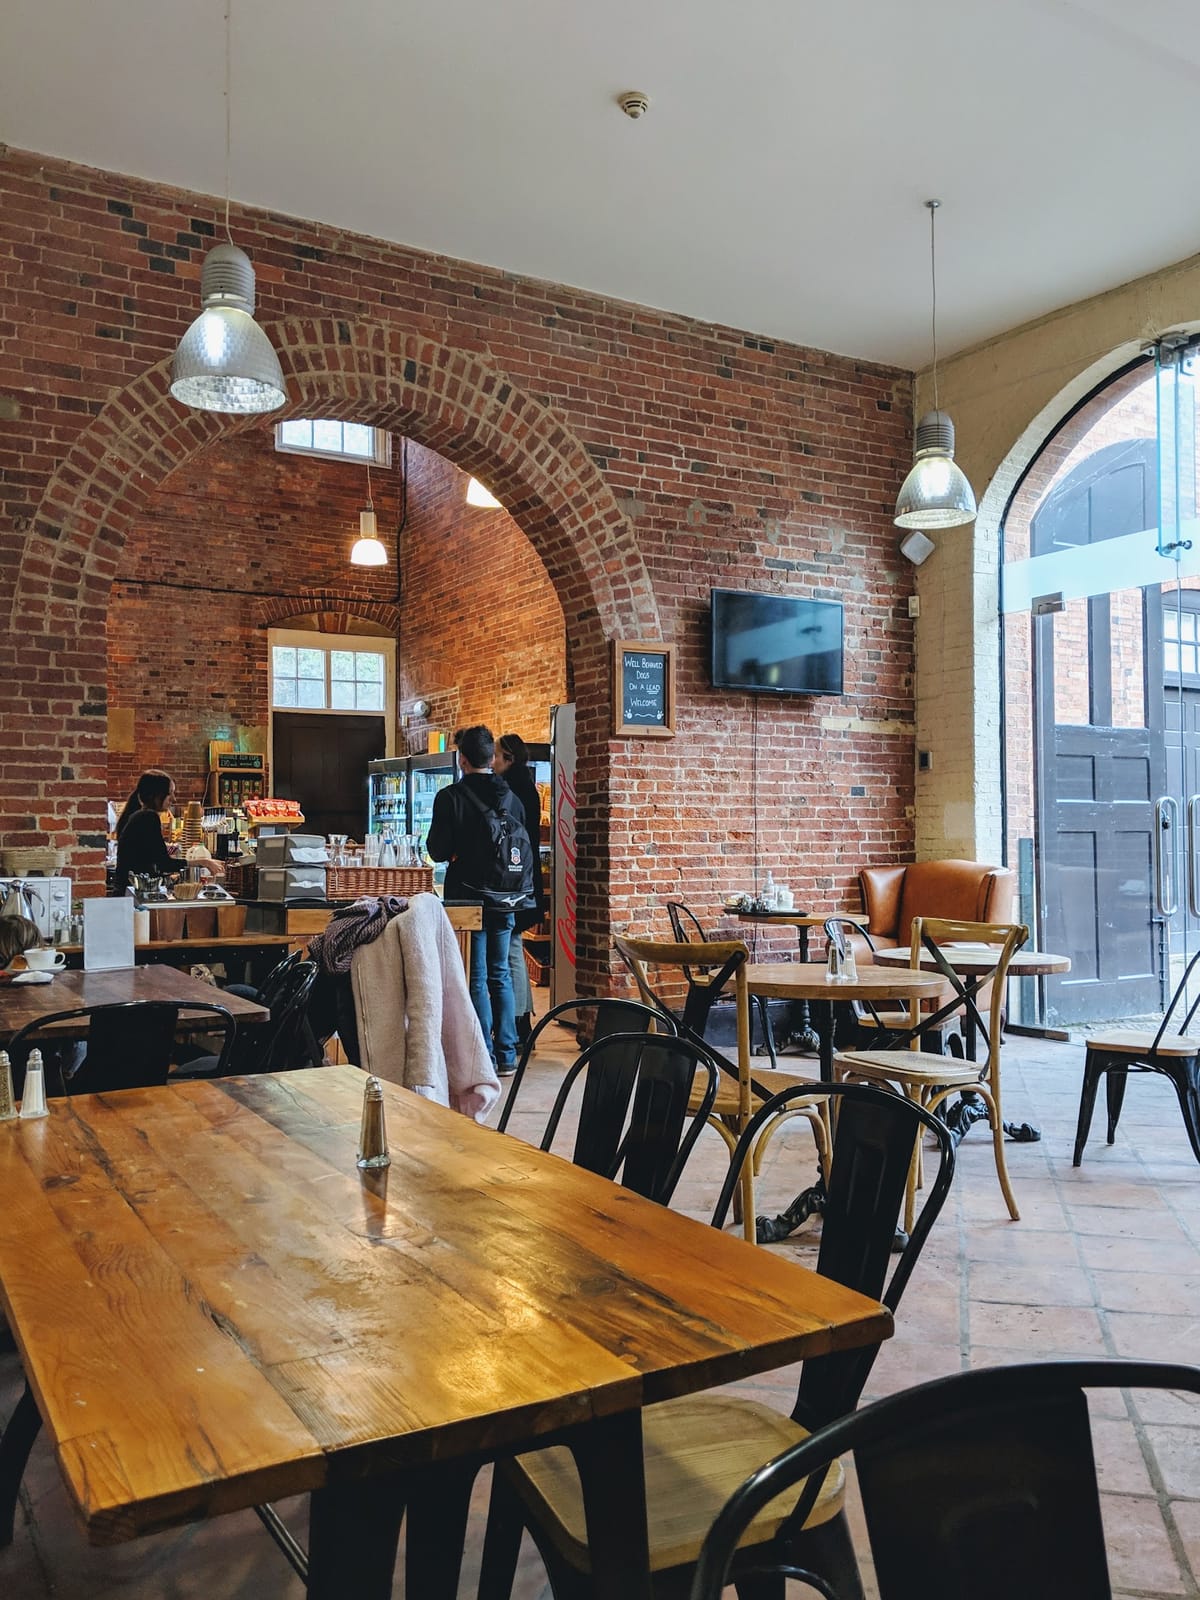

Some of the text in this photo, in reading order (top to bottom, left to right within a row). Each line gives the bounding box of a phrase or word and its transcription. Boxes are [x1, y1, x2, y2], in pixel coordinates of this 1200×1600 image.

[624, 656, 663, 669] WELL BEHAVED
[636, 671, 650, 680] DOGS
[629, 683, 637, 691] ON
[630, 697, 657, 707] WELCOME
